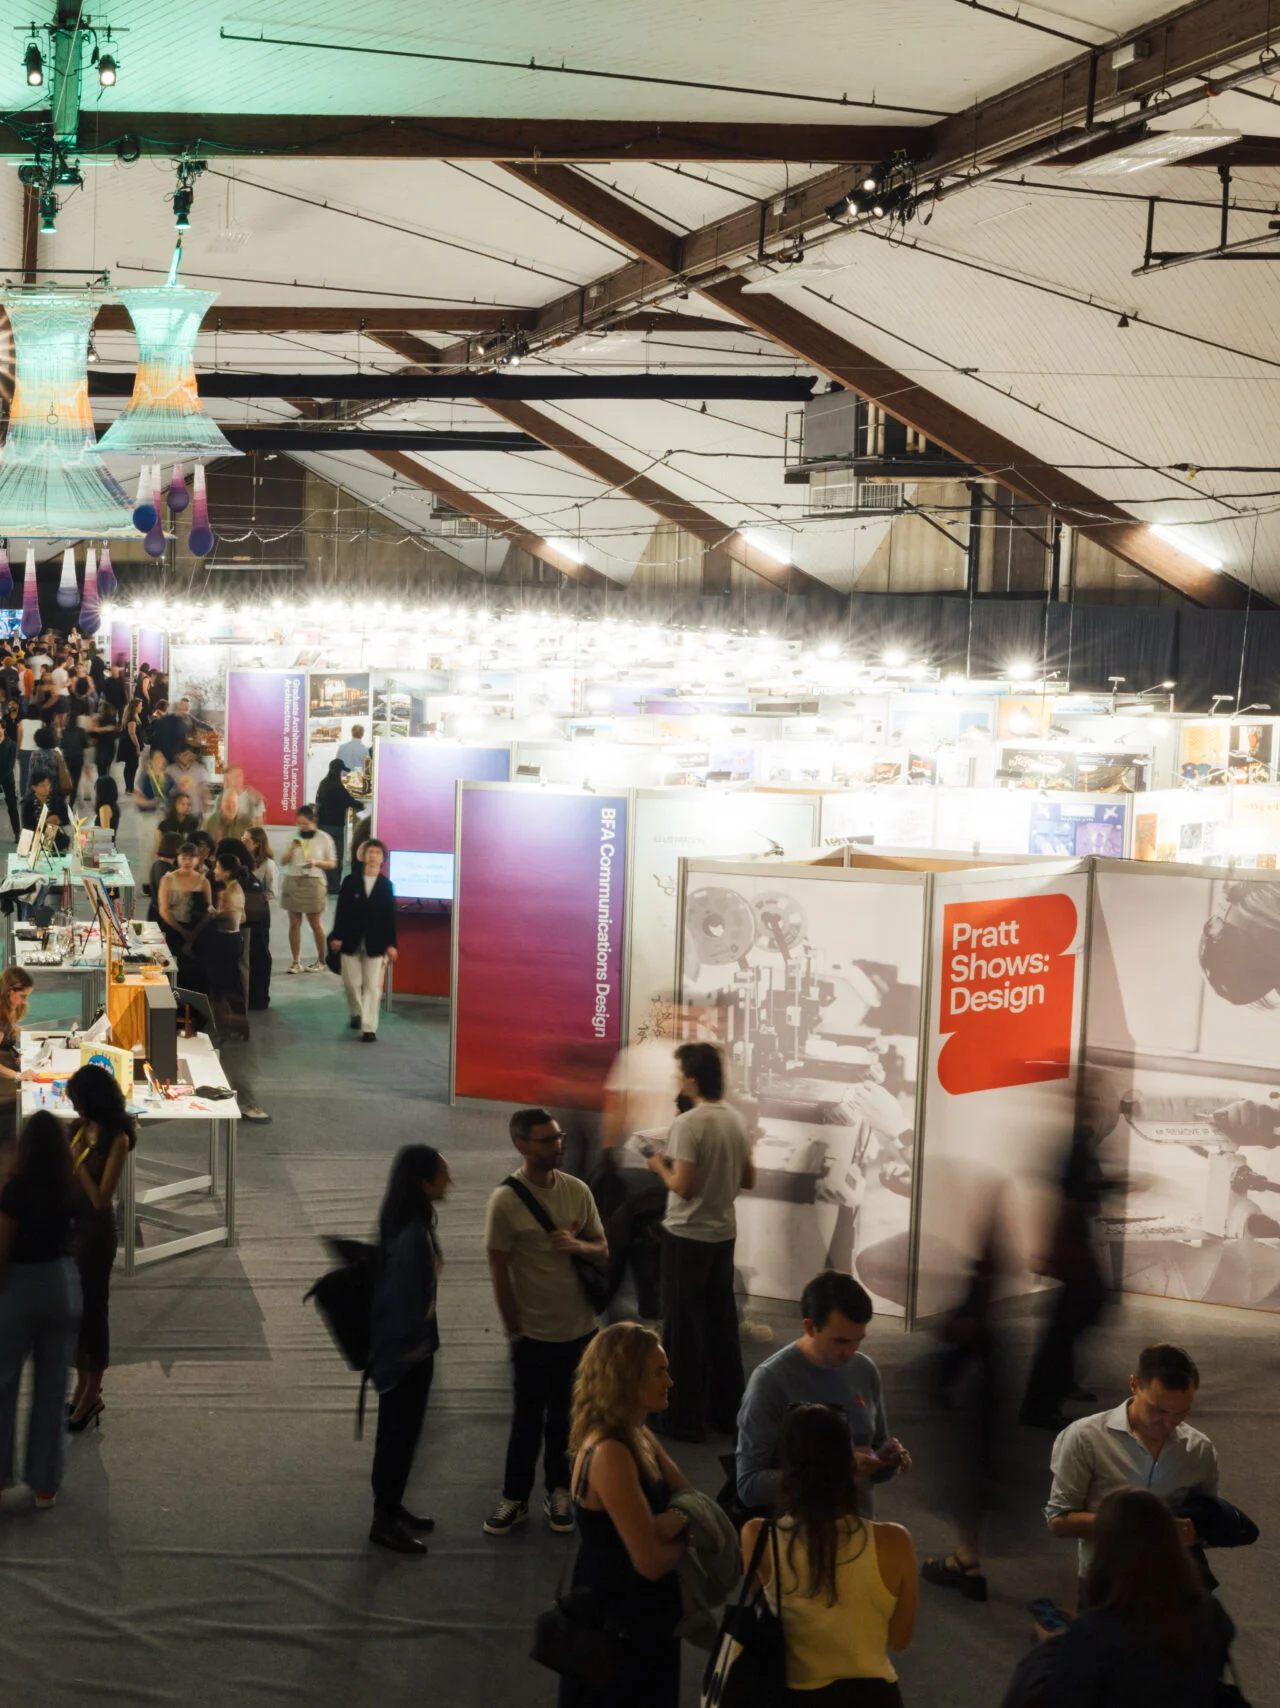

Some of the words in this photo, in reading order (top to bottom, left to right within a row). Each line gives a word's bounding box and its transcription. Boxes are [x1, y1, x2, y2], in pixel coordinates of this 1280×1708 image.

[284, 679, 292, 734] Architecture,
[292, 679, 300, 715] Graduate
[291, 715, 300, 766] Architecture,
[283, 755, 291, 780] Urban
[281, 782, 291, 811] Design
[290, 768, 299, 810] Landscape
[600, 807, 616, 841] BFA
[596, 844, 616, 981] Communications
[952, 920, 1020, 951] Pratt
[950, 952, 1050, 983] Shows:
[592, 984, 611, 1038] Design
[950, 980, 1045, 1015] Design
